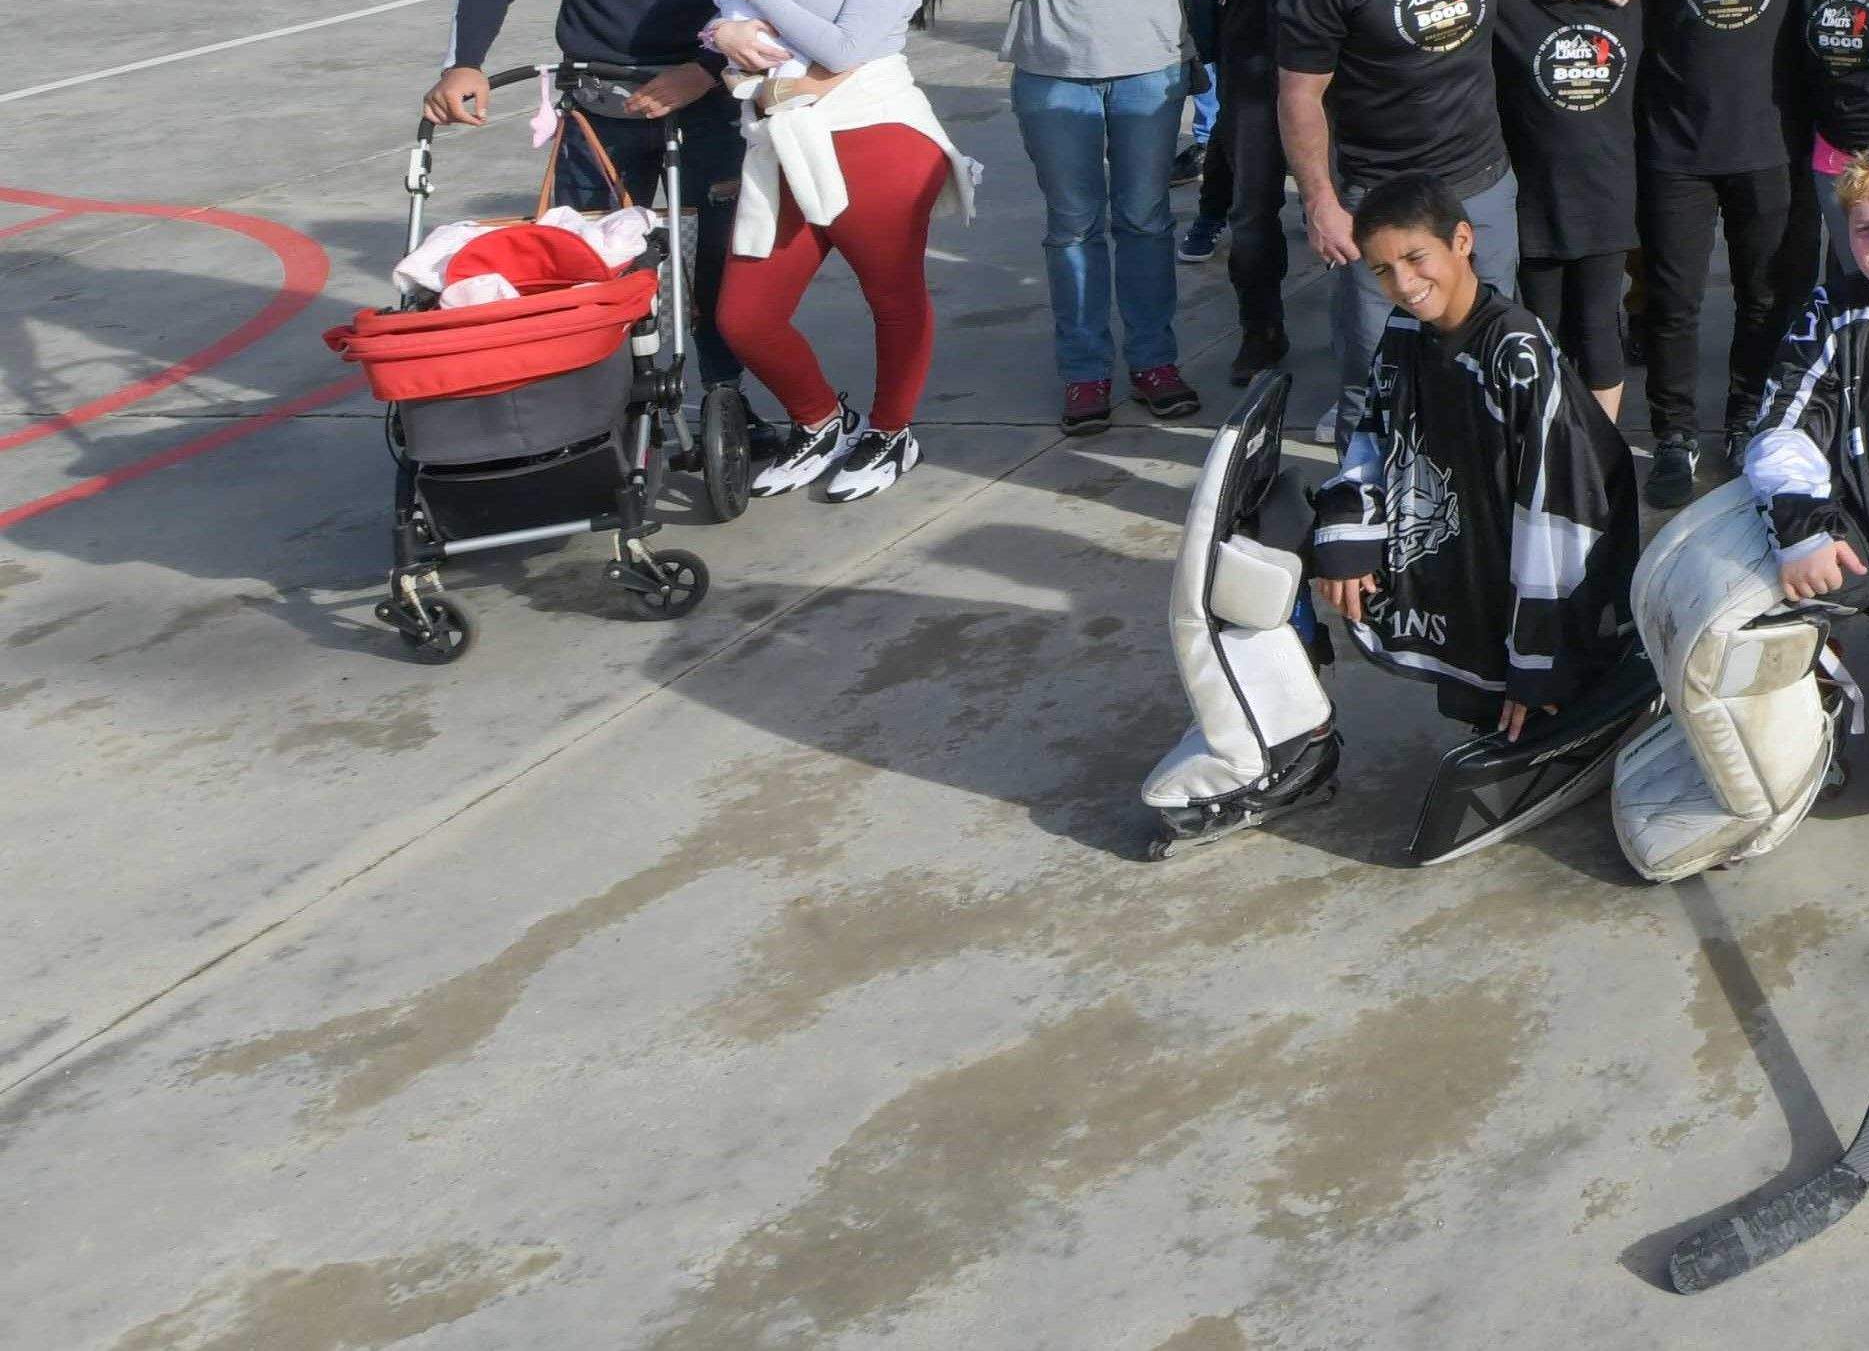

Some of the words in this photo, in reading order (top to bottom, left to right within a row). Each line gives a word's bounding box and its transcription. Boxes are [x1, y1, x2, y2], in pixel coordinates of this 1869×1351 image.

[1417, 1, 1469, 28] 8000
[1819, 34, 1863, 49] 8000
[1555, 49, 1592, 60] LIMITS
[1553, 67, 1610, 80] 8000
